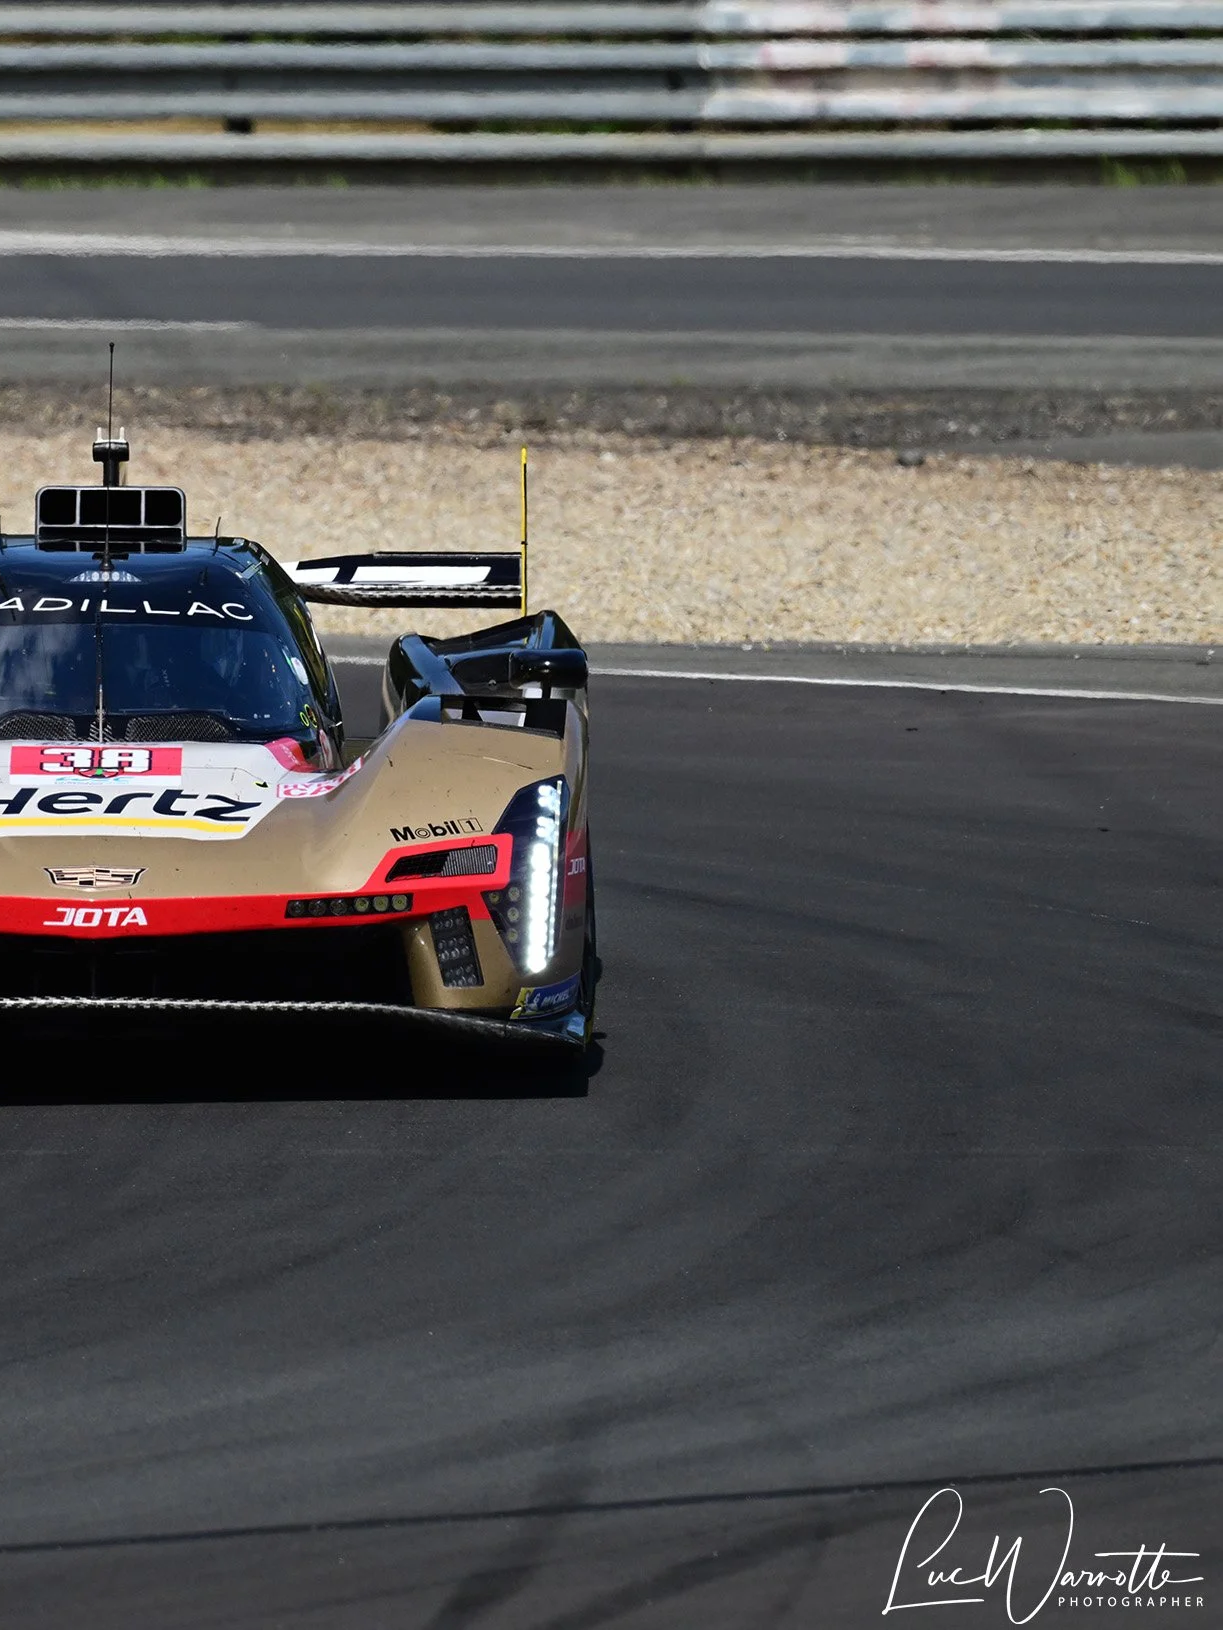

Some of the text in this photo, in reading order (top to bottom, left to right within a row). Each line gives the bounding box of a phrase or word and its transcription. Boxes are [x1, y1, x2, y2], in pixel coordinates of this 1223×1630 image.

[40, 748, 153, 773] 38
[389, 820, 461, 842] Mobil
[42, 906, 149, 928] JOTA
